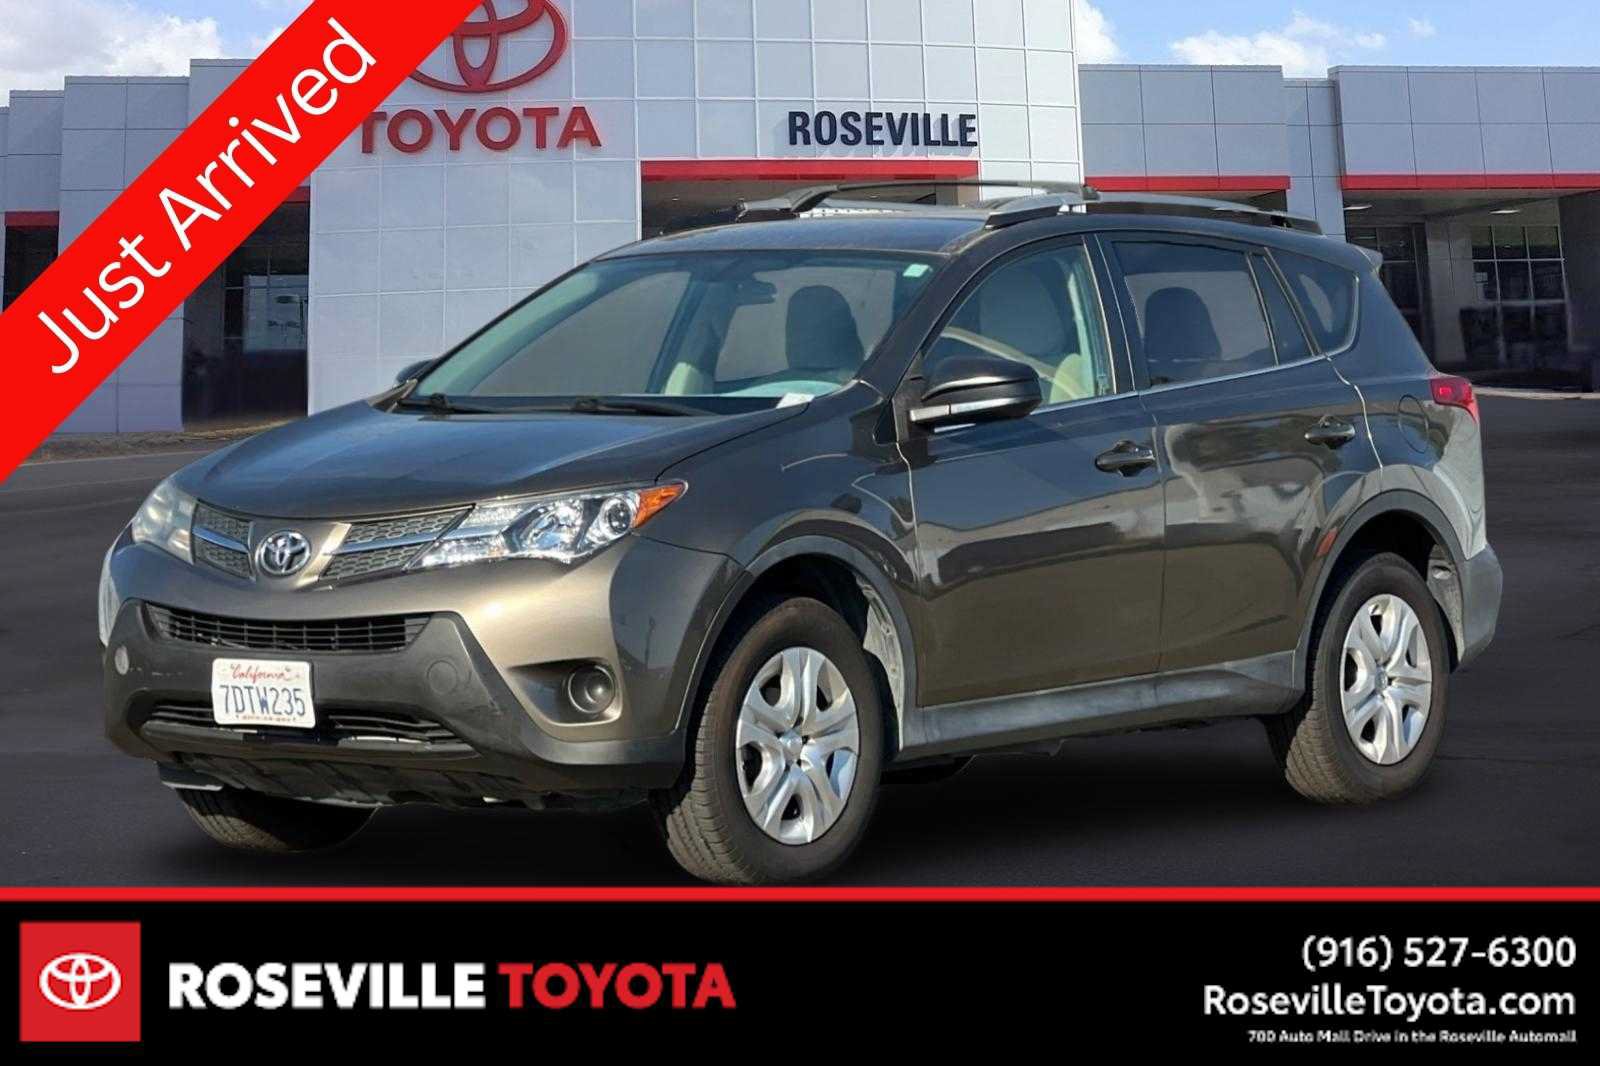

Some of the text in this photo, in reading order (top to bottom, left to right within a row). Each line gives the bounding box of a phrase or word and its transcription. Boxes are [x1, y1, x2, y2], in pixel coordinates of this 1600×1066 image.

[361, 106, 602, 154] TOYOTA
[788, 111, 978, 147] ROSEVILLE
[231, 664, 287, 683] California
[220, 685, 306, 716] 7DTW235
